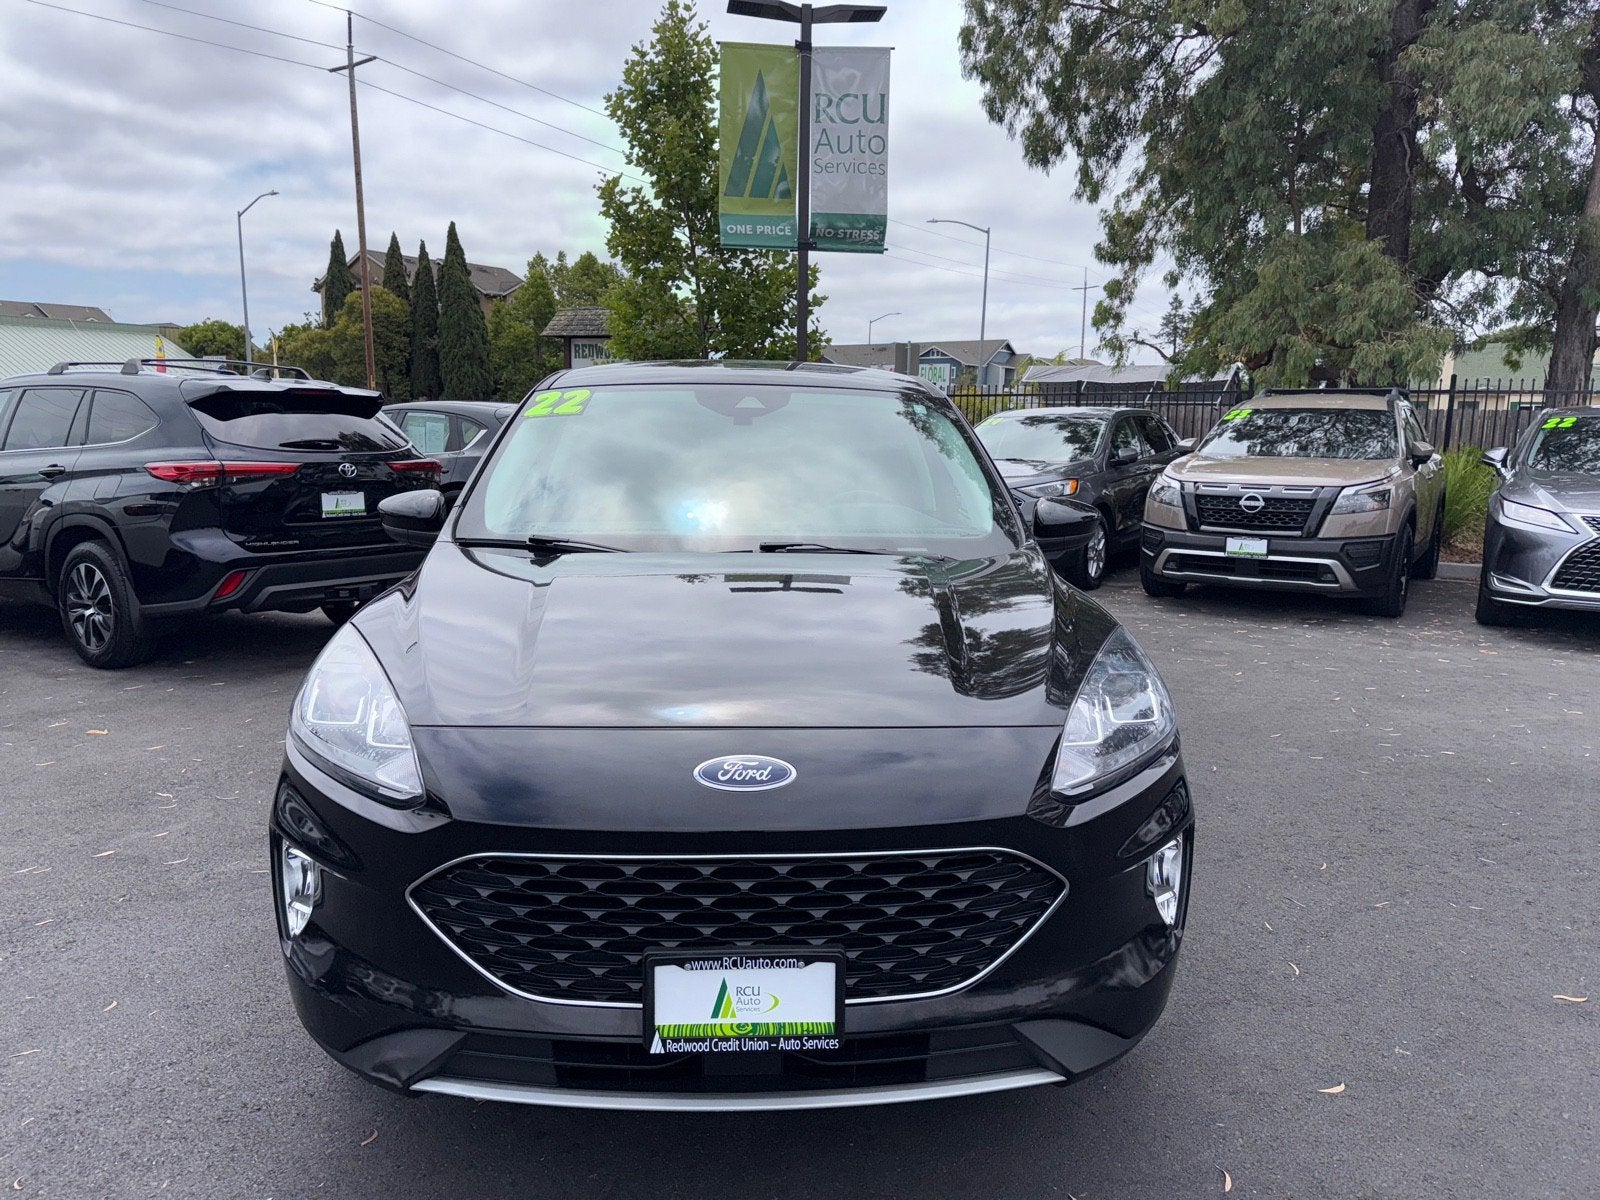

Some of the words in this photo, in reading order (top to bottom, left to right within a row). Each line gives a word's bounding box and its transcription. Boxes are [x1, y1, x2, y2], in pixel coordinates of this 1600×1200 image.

[814, 92, 886, 124] RCU
[814, 127, 886, 155] Auto
[813, 158, 886, 176] Services
[726, 224, 753, 235] ONE
[756, 225, 792, 236] PRICE
[815, 228, 836, 239] NO
[837, 229, 881, 241] STRESS
[920, 366, 946, 382] FLORAL
[523, 389, 590, 417] 22
[1541, 417, 1578, 429] 22
[717, 760, 773, 781] Ford
[691, 956, 798, 970] www.RCUauto.com
[735, 986, 761, 997] RCU
[735, 997, 761, 1006] Auto
[666, 1038, 710, 1053] Redwood
[711, 1037, 740, 1052] Credit
[741, 1037, 769, 1051] Union
[778, 1037, 801, 1051] Auto
[802, 1035, 839, 1050] Services
